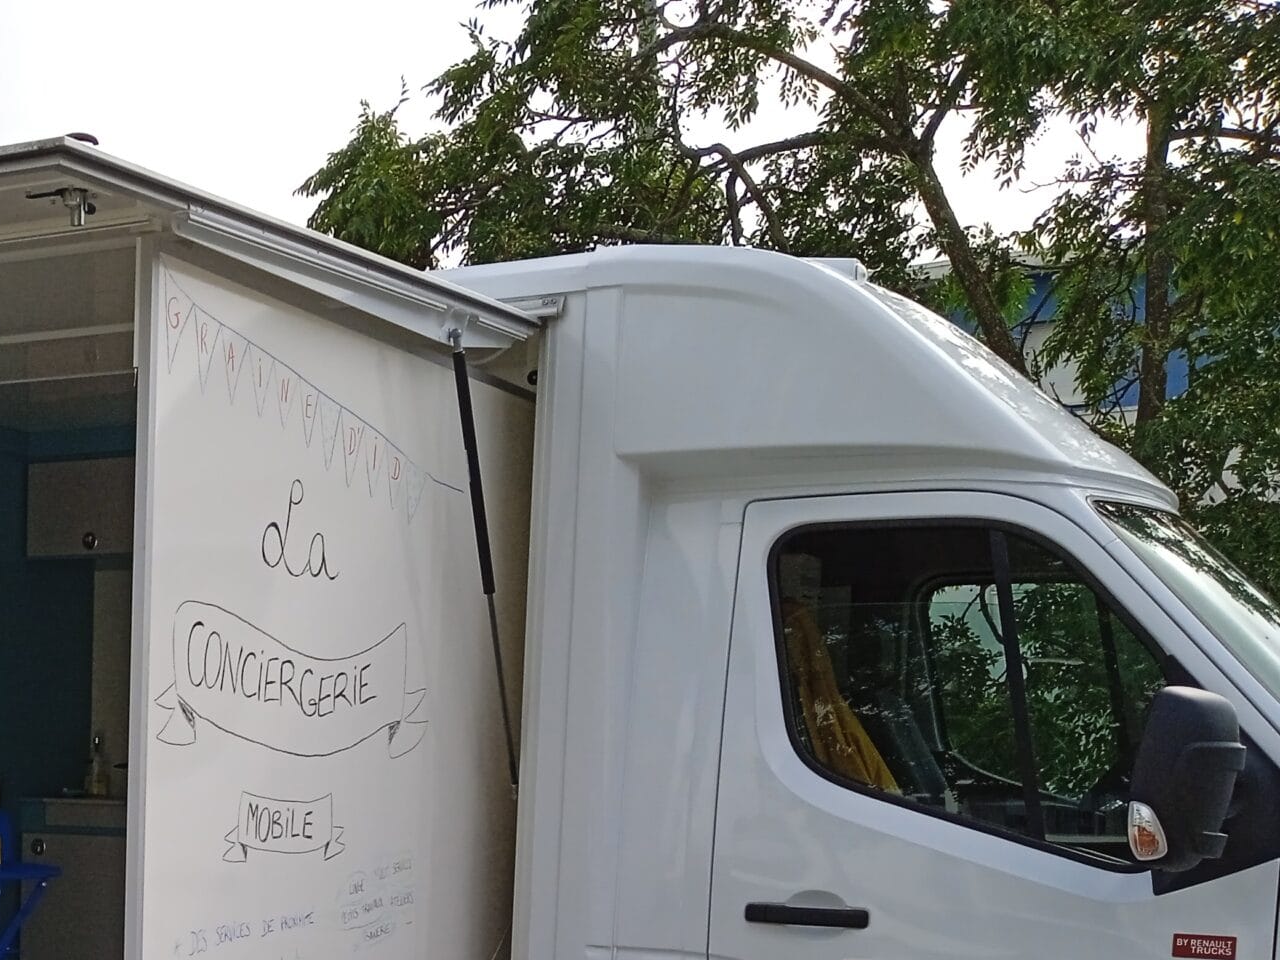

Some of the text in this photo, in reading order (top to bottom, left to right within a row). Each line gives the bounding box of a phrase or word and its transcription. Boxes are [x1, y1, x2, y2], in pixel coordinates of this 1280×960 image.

[261, 479, 340, 580] La
[1176, 938, 1232, 949] BY RENAULT
[1191, 946, 1232, 956] TRUCKS
